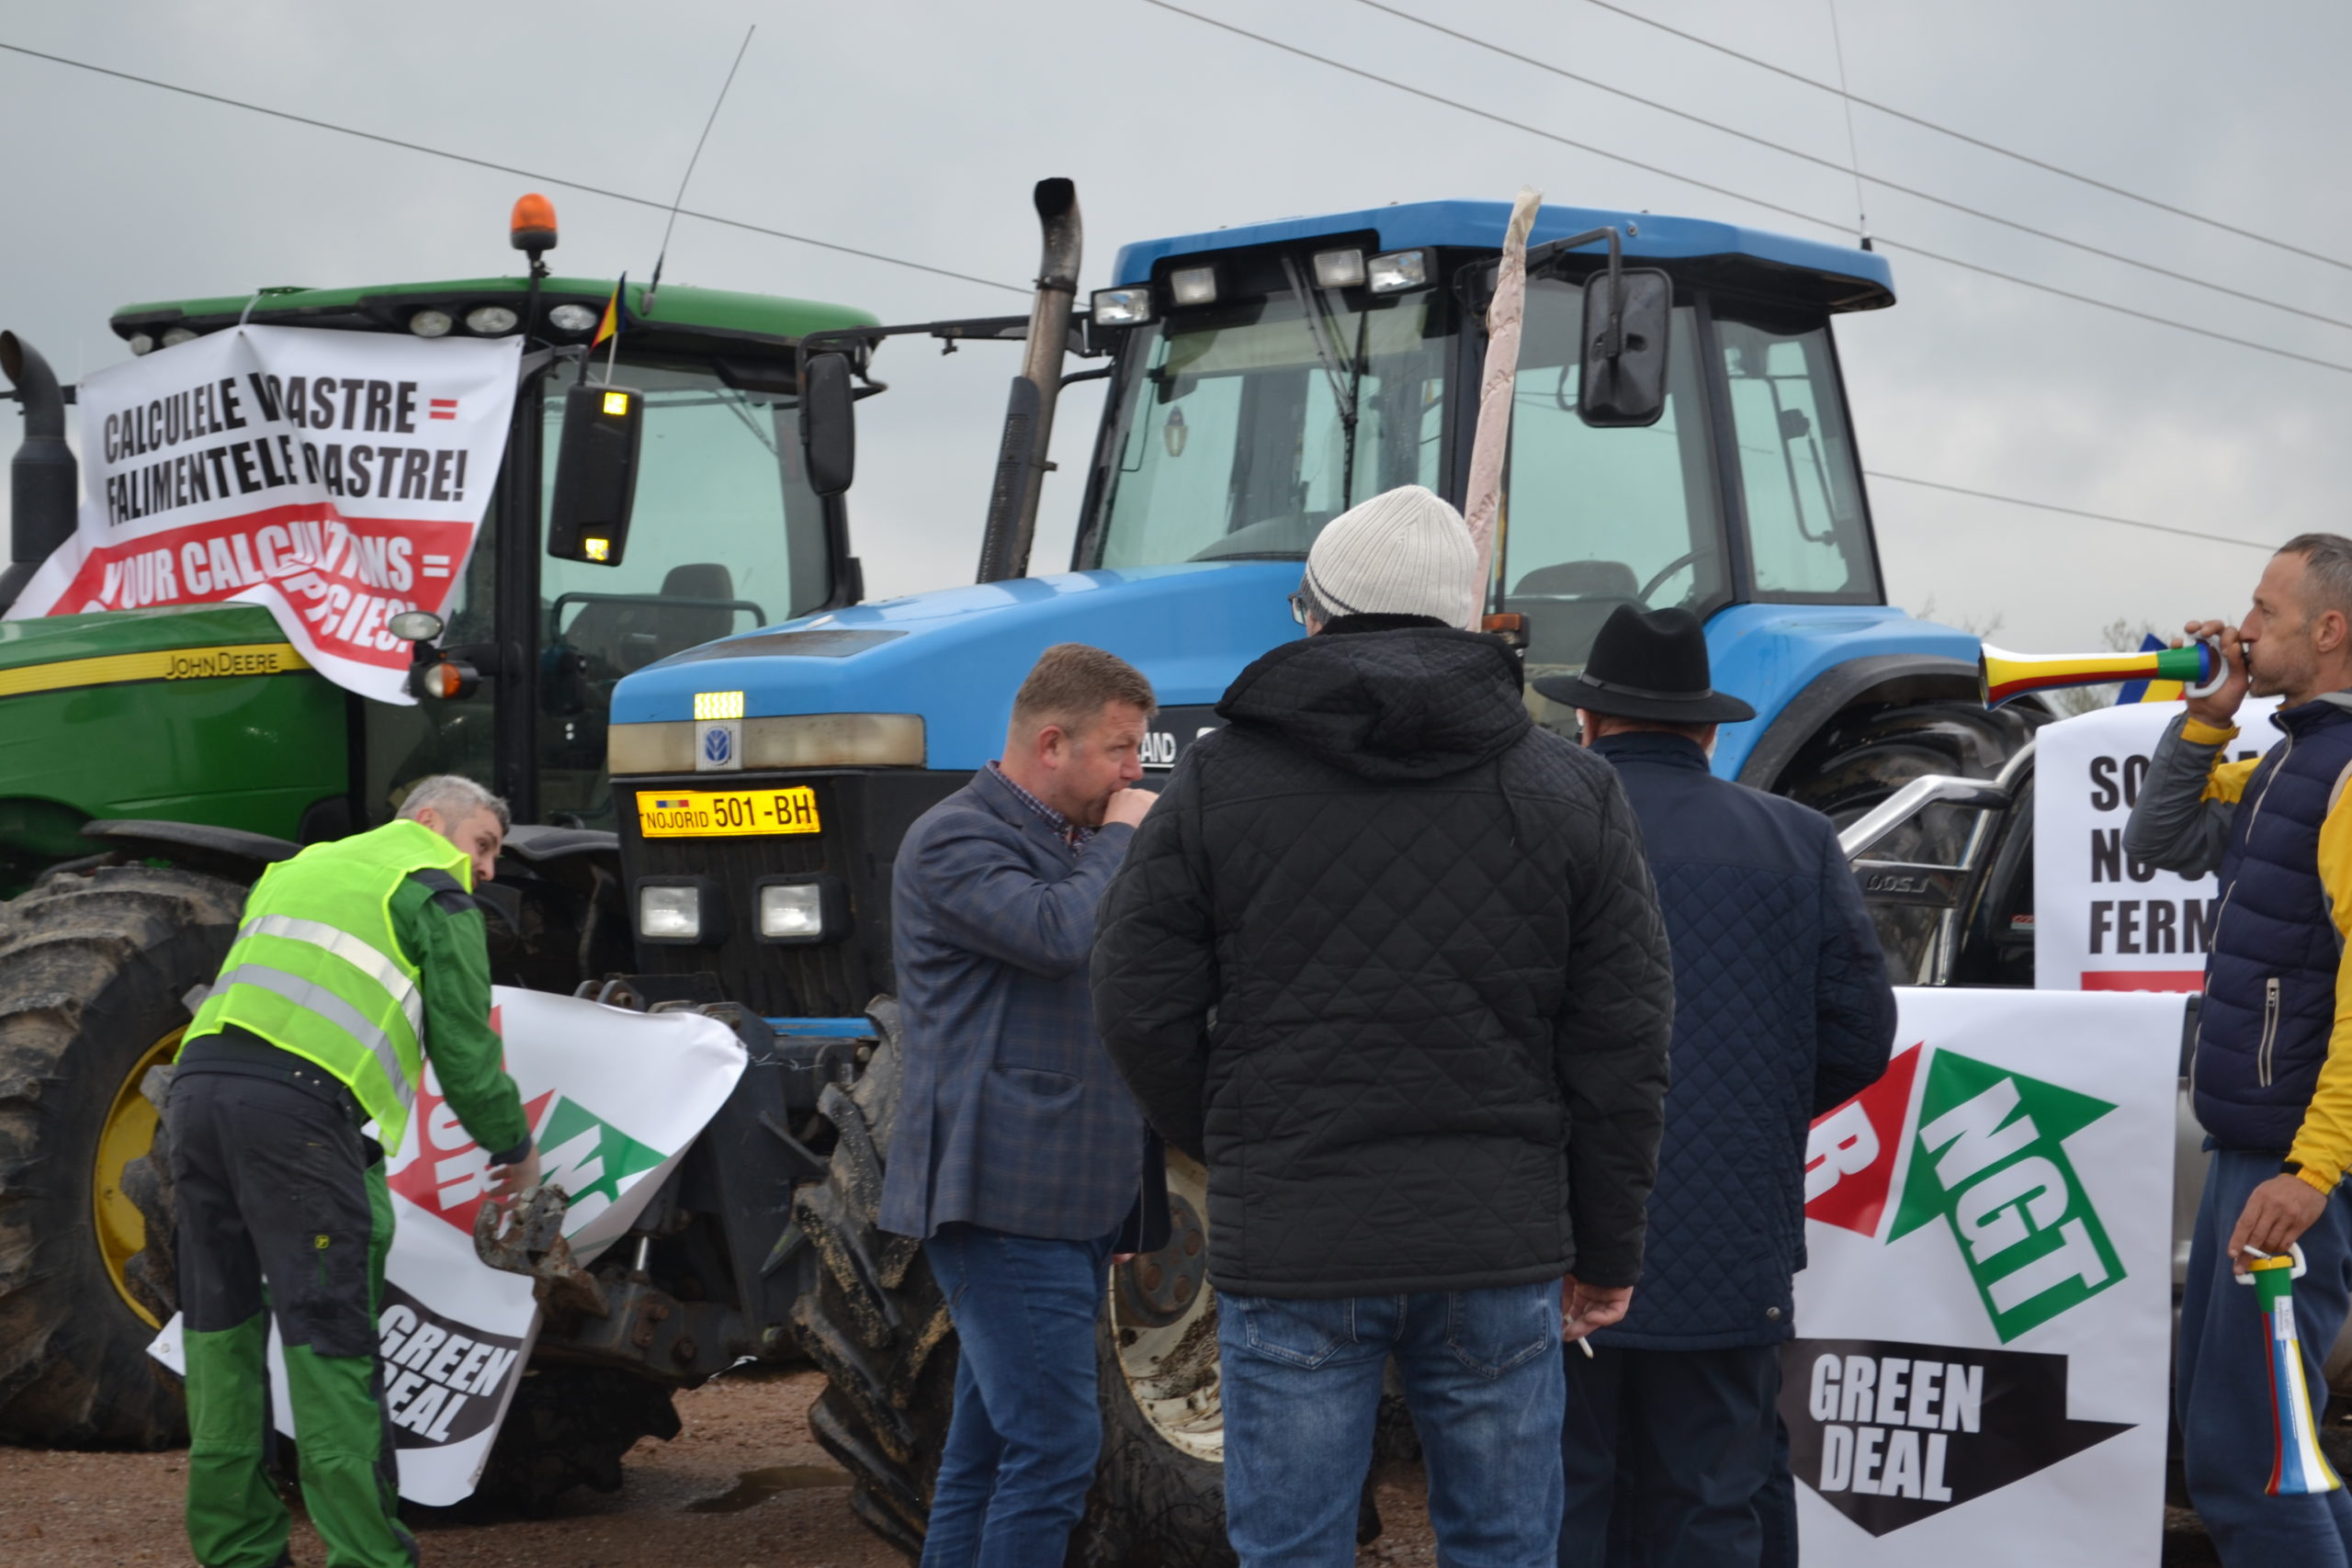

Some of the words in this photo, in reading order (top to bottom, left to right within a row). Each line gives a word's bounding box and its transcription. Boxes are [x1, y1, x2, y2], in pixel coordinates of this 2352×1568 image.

[104, 378, 247, 464] CALCULELE
[106, 434, 298, 527] FALIMENTELE
[98, 548, 179, 609] YOUR
[165, 655, 215, 677] JOHN
[218, 652, 279, 672] DEERE
[1139, 731, 1176, 763] AND
[646, 811, 709, 829] NOJORID
[1918, 1077, 2110, 1316] NGT
[379, 1304, 519, 1397] GREEN
[1808, 1353, 1984, 1434] GREEN
[1819, 1424, 1953, 1503] DEAL
